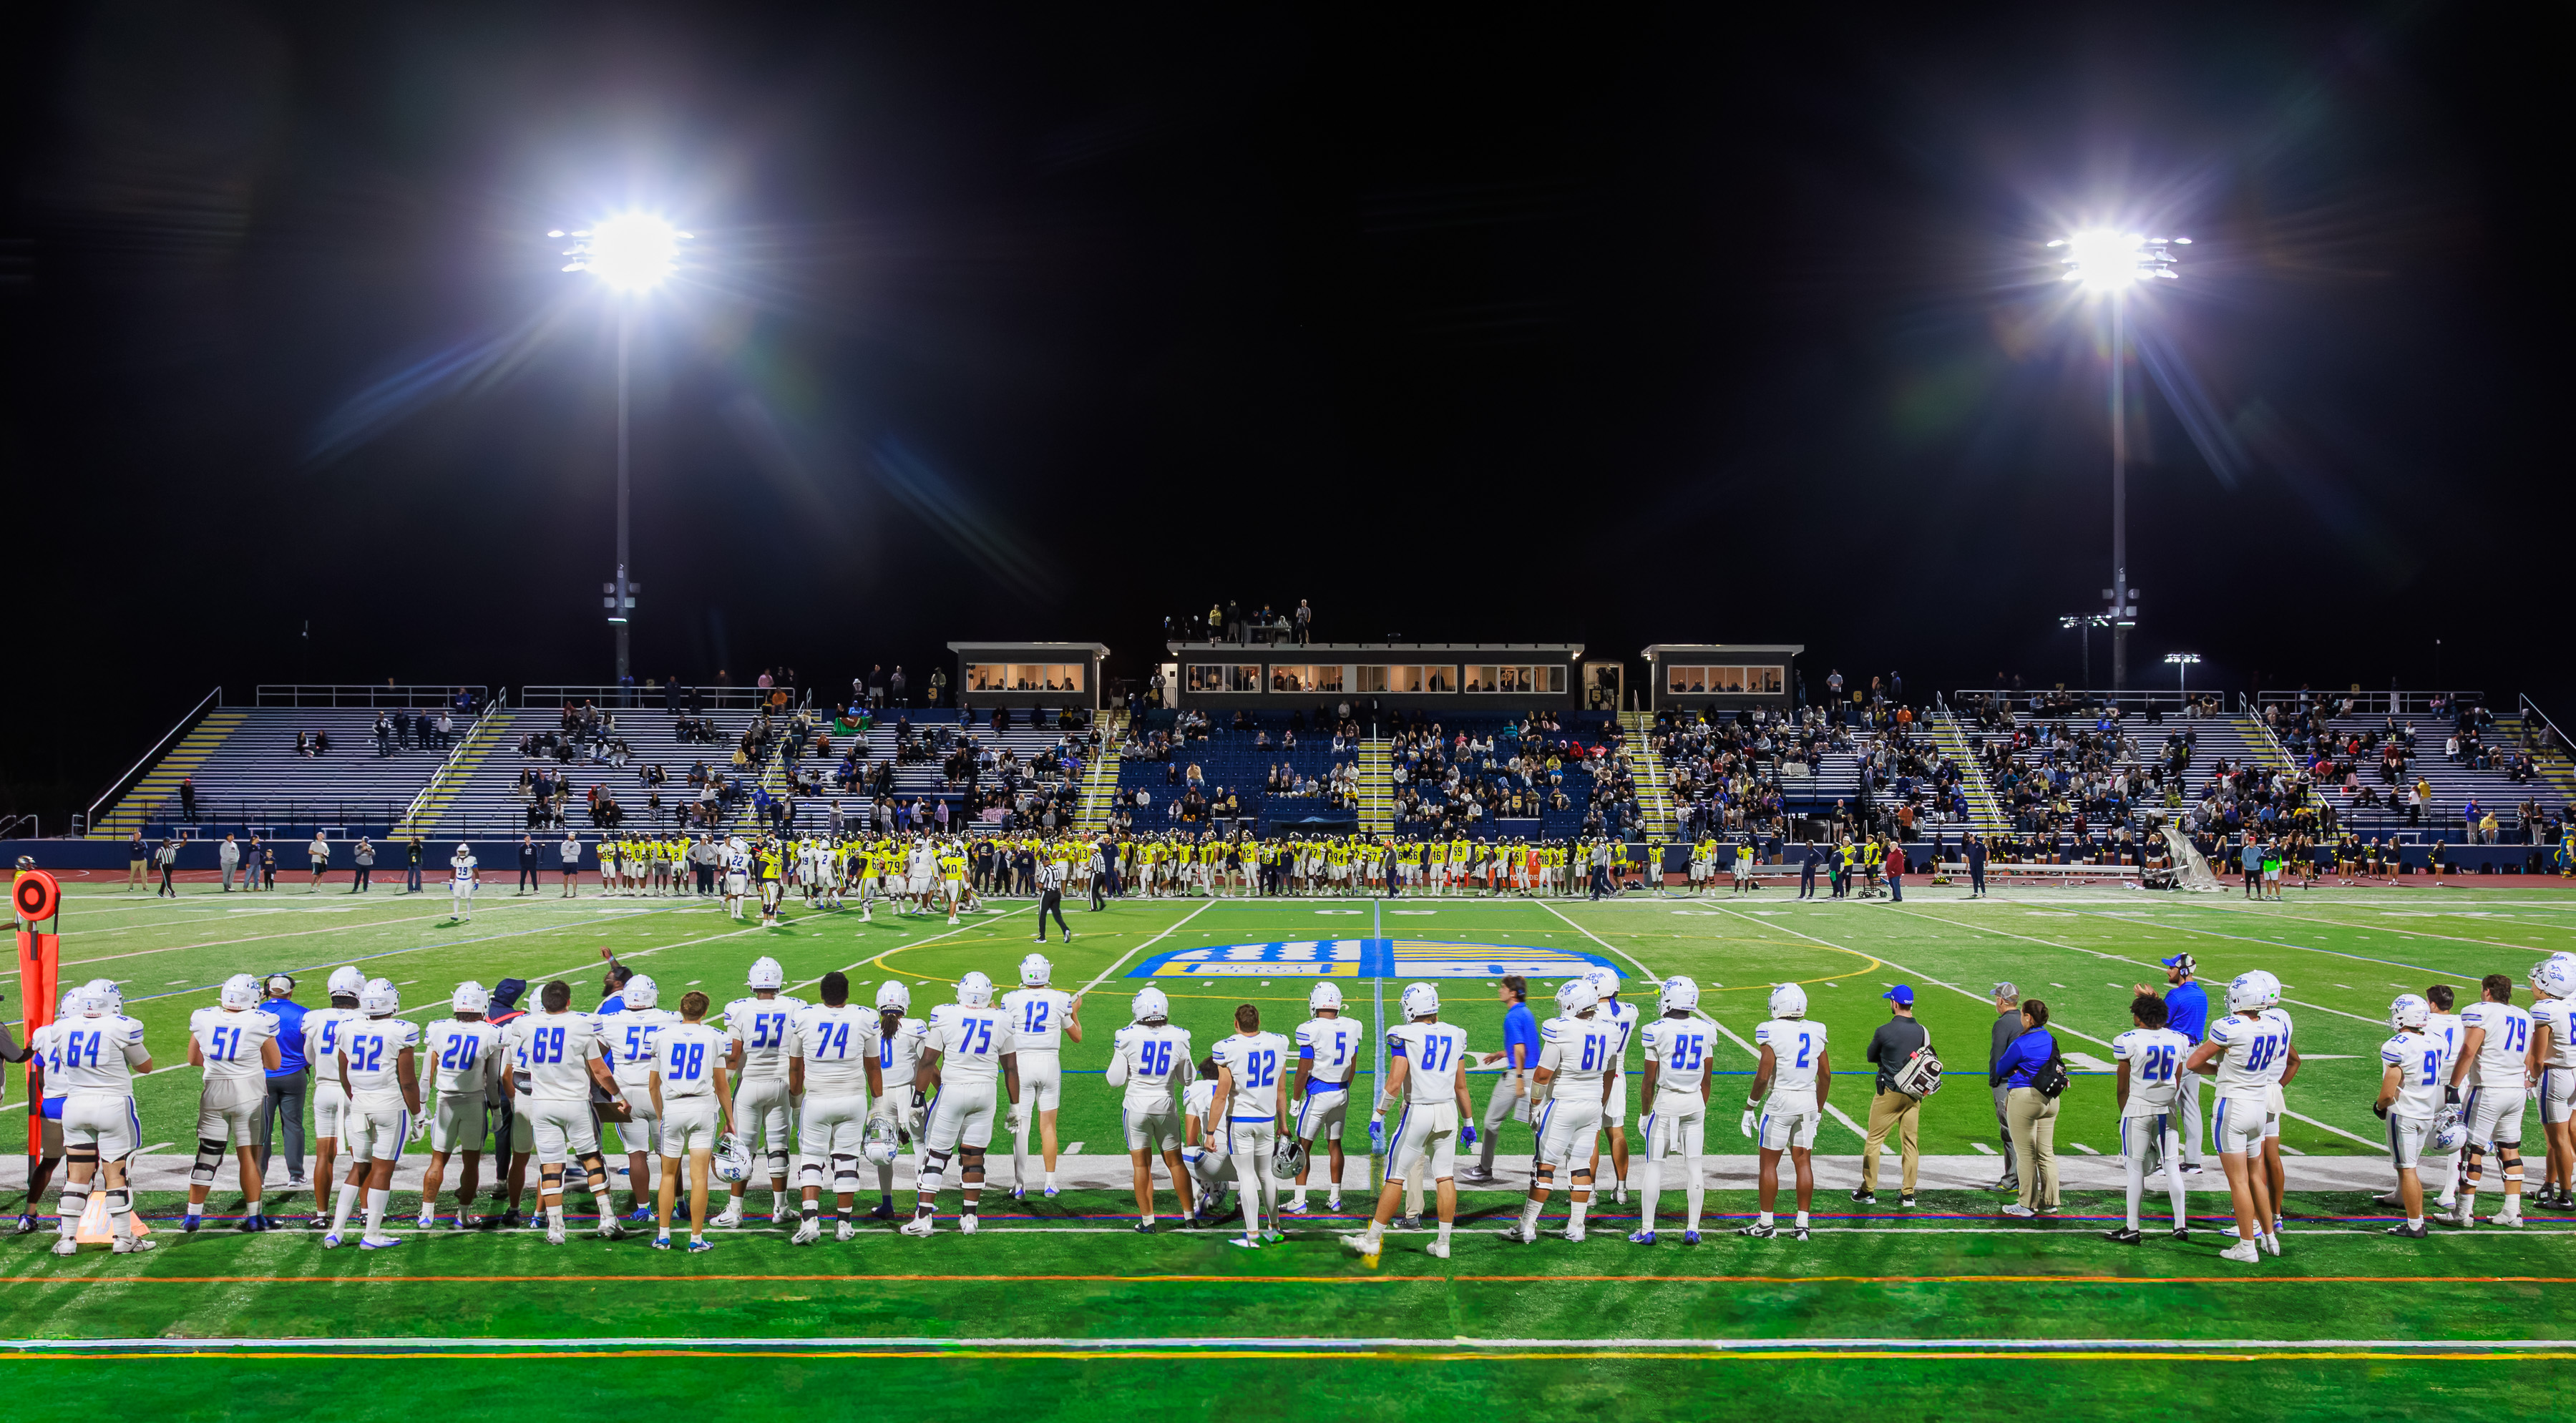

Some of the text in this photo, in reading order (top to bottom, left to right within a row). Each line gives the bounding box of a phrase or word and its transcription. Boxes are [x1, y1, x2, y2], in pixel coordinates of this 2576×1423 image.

[928, 688, 937, 700] 3
[1592, 690, 1601, 702] 5
[1226, 795, 1238, 808] 4
[1511, 796, 1522, 809] 5
[458, 866, 468, 876] 39
[635, 849, 640, 859] 0
[674, 852, 679, 862] 2
[731, 855, 743, 867] 22
[822, 854, 828, 865] 2
[887, 861, 900, 873] 79
[1079, 849, 1088, 860] 13
[1333, 853, 1344, 864] 94
[751, 1014, 786, 1047] 53
[1024, 1001, 1049, 1033] 12
[67, 1031, 101, 1067] 64
[210, 1027, 241, 1062] 51
[321, 1020, 339, 1055] 9
[533, 1027, 565, 1063] 69
[816, 1022, 850, 1059] 74
[959, 1018, 994, 1055] 75
[1333, 1032, 1346, 1066] 5
[1671, 1034, 1704, 1070] 85
[1795, 1032, 1810, 1069] 2
[2504, 1017, 2527, 1053] 79
[351, 1035, 384, 1071] 52
[441, 1035, 479, 1071] 20
[668, 1043, 705, 1080] 98
[1138, 1041, 1172, 1075] 96
[1246, 1050, 1276, 1088] 92
[1421, 1035, 1452, 1072] 87
[1581, 1035, 1606, 1071] 61
[2142, 1045, 2175, 1081] 26
[2245, 1035, 2278, 1072] 88
